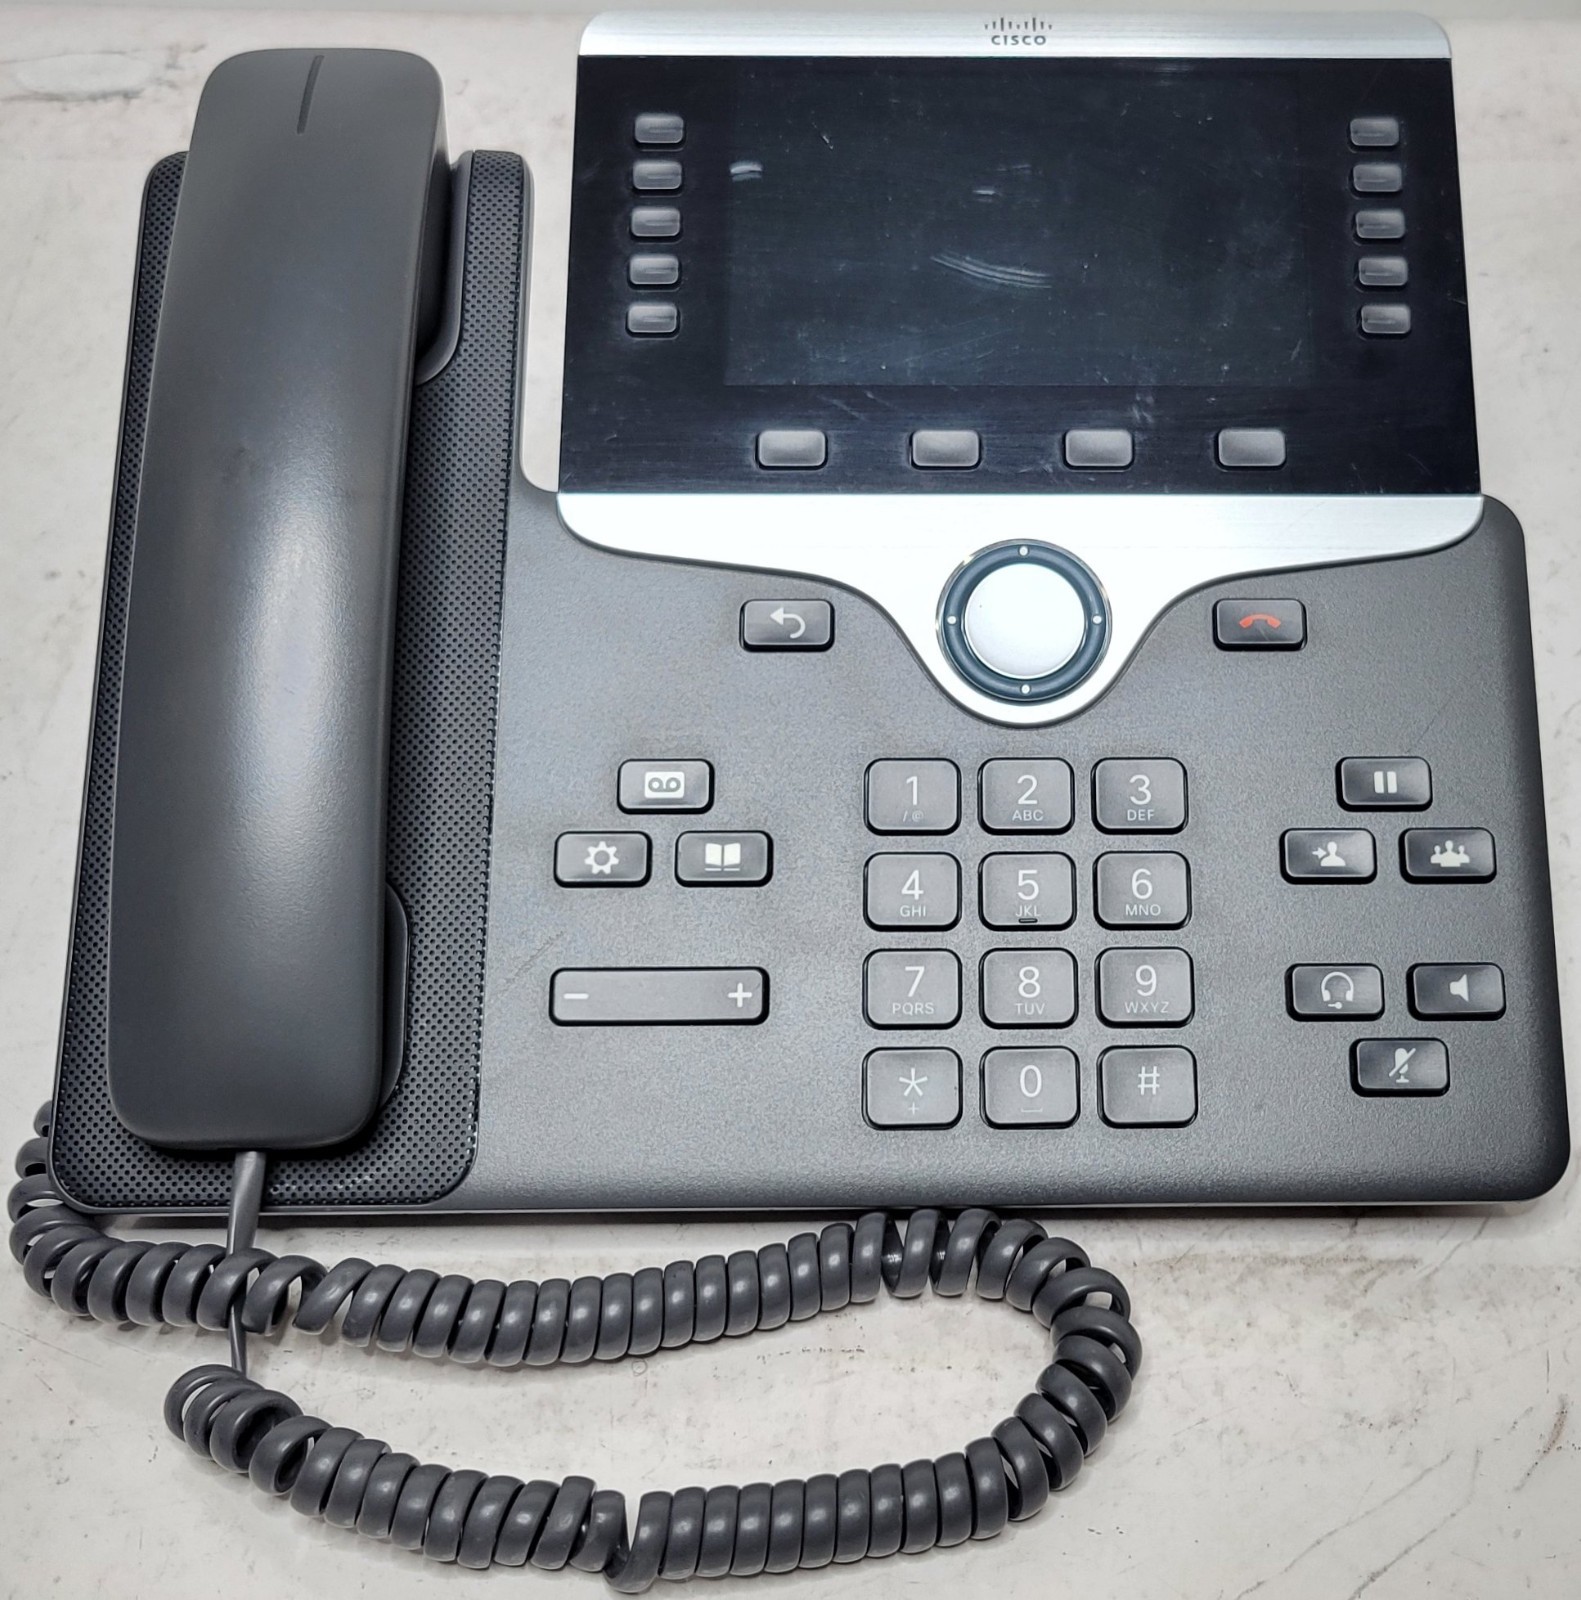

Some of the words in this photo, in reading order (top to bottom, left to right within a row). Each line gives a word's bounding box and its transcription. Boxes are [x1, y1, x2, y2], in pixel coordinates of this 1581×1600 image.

[991, 35, 1046, 46] CISCO
[905, 775, 919, 806] 1
[1016, 774, 1038, 805] 2
[1129, 774, 1152, 805] 3
[1011, 808, 1044, 822] ABC
[1126, 808, 1155, 822] DEF
[901, 869, 924, 901] 4
[1017, 869, 1039, 901] 5
[1131, 868, 1153, 900] 6
[899, 905, 927, 918] GHI
[1014, 905, 1041, 918] JKL
[1124, 904, 1162, 917] MNO
[904, 965, 925, 998] 7
[1018, 966, 1041, 999] 8
[1135, 965, 1158, 997] 9
[891, 1001, 935, 1016] PQRS
[1015, 1002, 1046, 1016] TUV
[1124, 1001, 1170, 1015] WXYZ
[1019, 1064, 1042, 1098] 0
[1137, 1066, 1161, 1096] #
